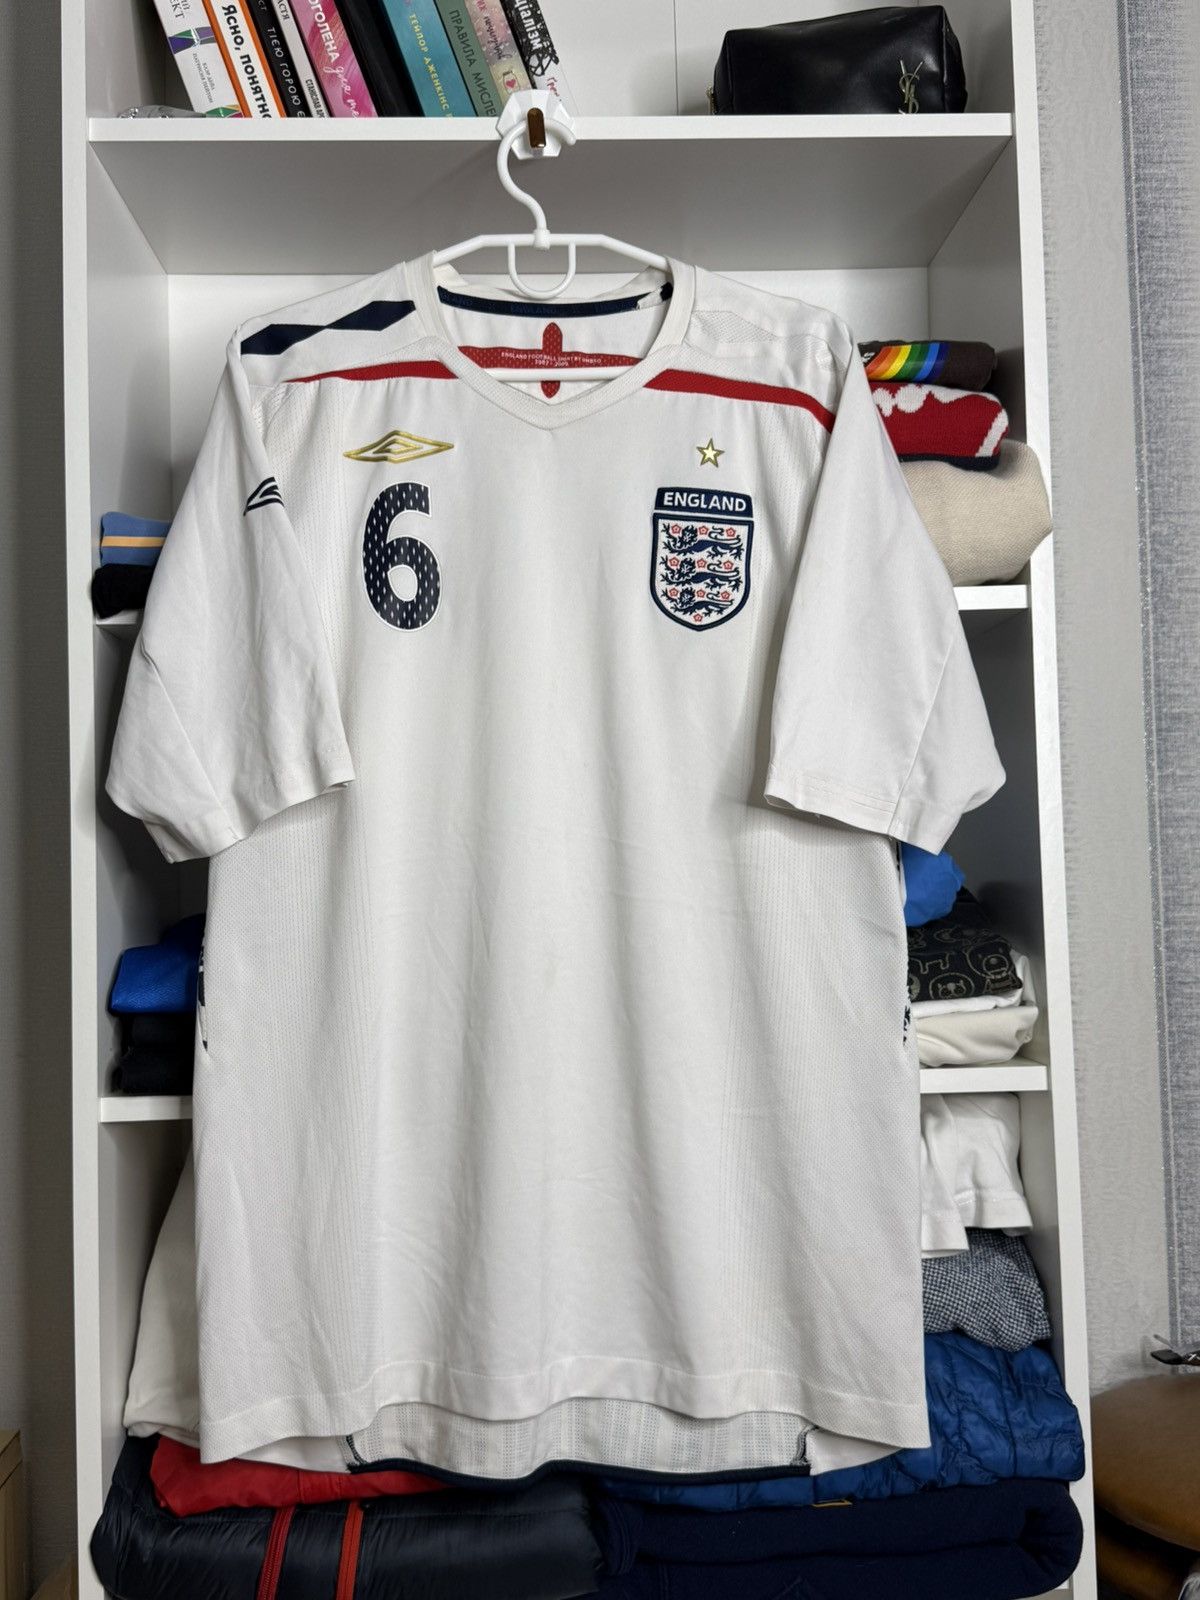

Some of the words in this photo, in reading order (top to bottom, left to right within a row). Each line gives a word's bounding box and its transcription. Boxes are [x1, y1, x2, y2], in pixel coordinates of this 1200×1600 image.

[222, 5, 244, 50] Ясно,
[268, 27, 284, 57] ТІЄЮ
[280, 63, 300, 105] ГОРОЮ
[409, 14, 428, 52] ТЕЙЛОР
[424, 56, 450, 110] ДЖЕНКІНС
[449, 10, 477, 67] ПРАВИЛА
[472, 72, 497, 117] МИСЛЕ
[501, 352, 527, 360] ENGLAND
[663, 492, 746, 512] ENGLAND
[362, 482, 442, 632] 6
